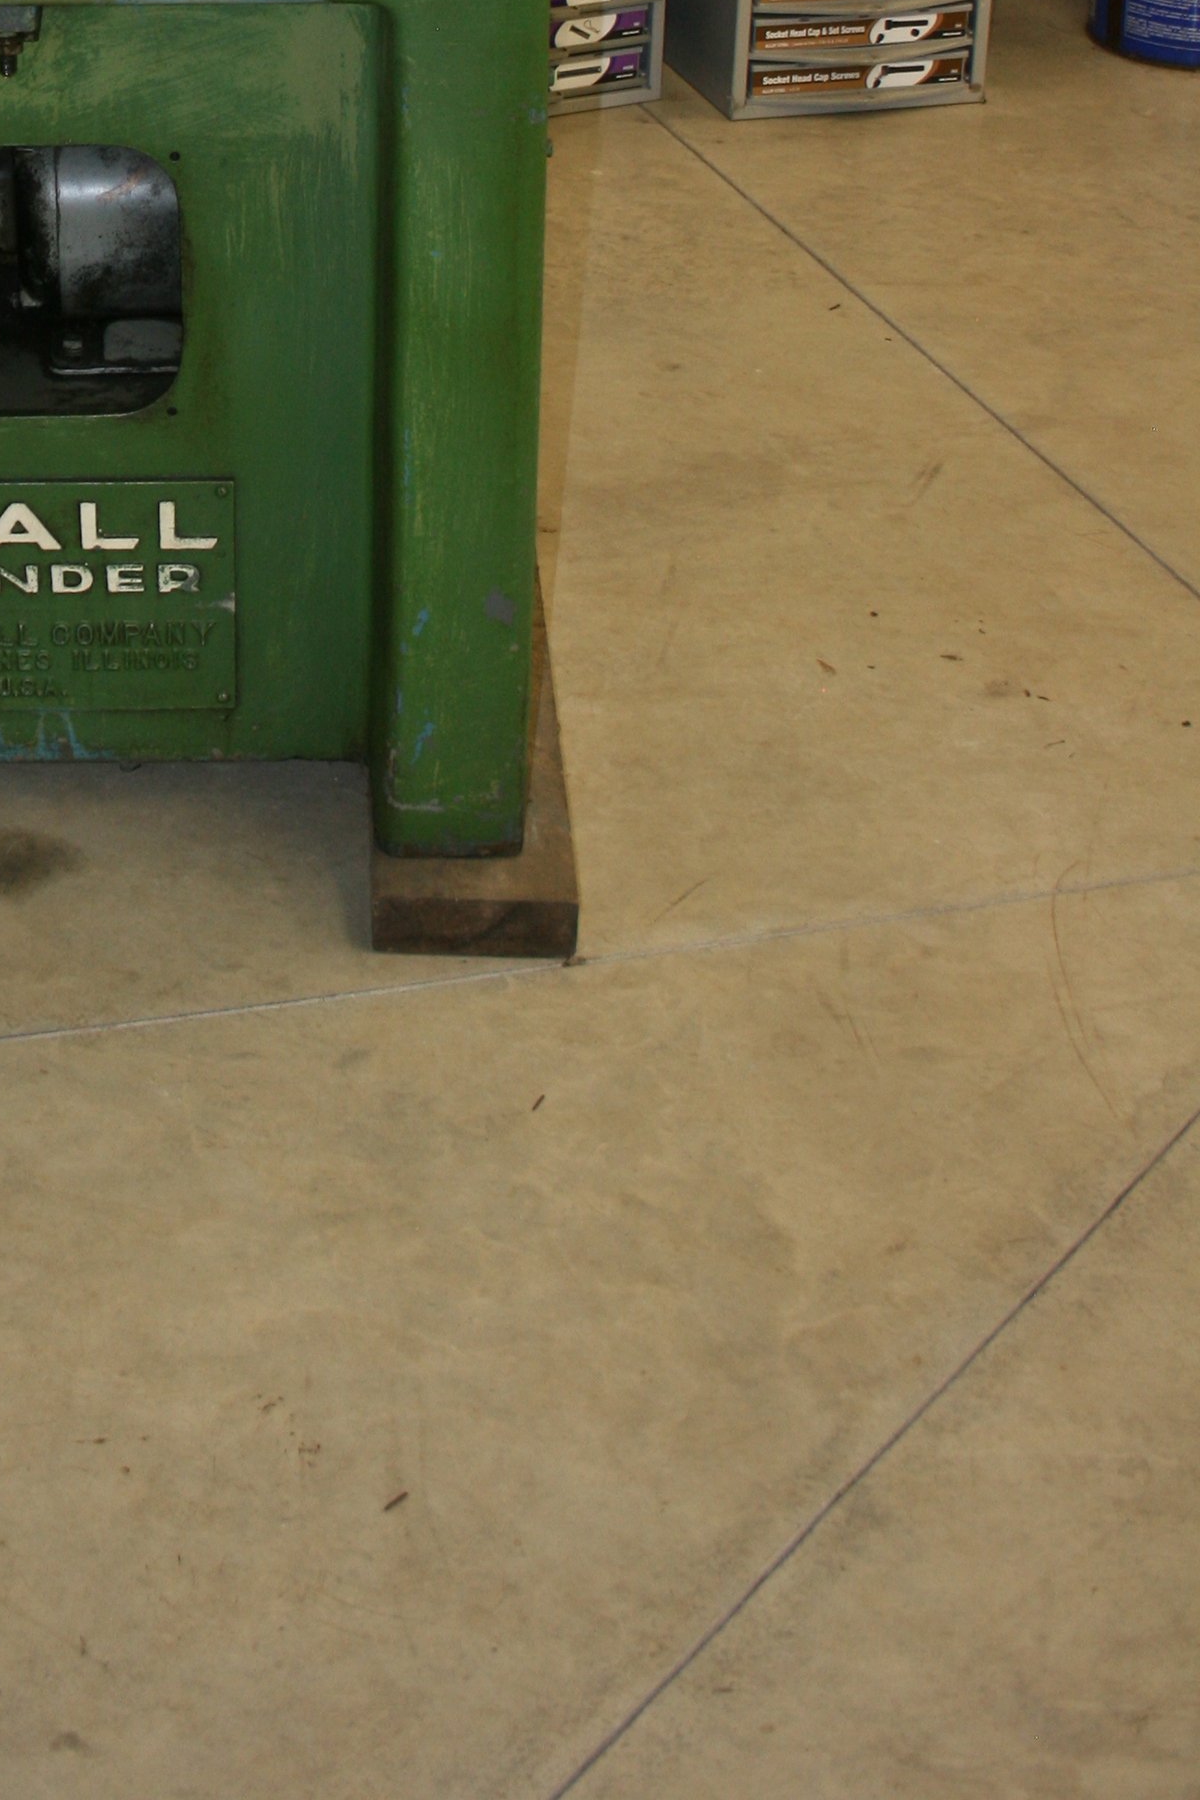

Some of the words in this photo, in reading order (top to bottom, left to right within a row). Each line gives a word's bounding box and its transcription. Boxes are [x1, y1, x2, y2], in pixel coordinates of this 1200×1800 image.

[765, 30, 788, 40] Socket
[789, 28, 806, 38] Head
[807, 28, 821, 37] Cap
[828, 26, 840, 35] Set
[840, 25, 865, 34] Screws
[762, 76, 790, 86] Socket
[791, 74, 812, 83] Head
[813, 73, 829, 82] Cap
[830, 72, 860, 81] Screws
[51, 620, 217, 647] COMPANY
[72, 650, 199, 672] ILLINOIS
